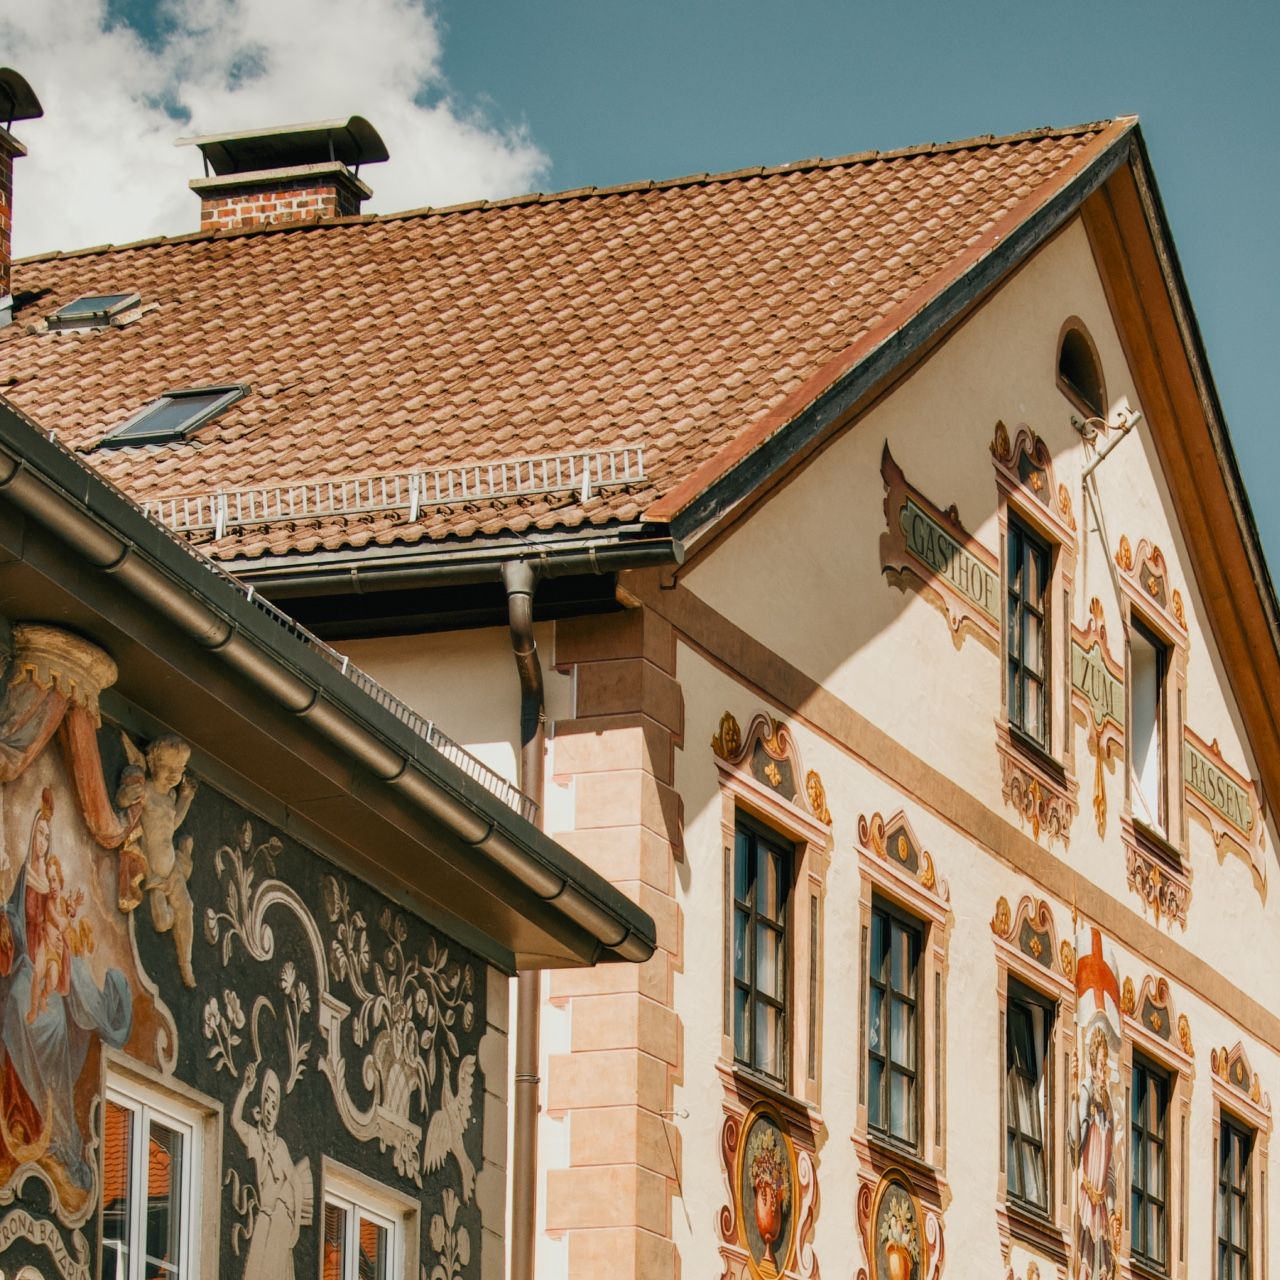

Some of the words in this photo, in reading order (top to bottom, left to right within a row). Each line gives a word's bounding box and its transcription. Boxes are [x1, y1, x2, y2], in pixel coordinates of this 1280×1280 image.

[912, 513, 994, 610] GASTHOF
[1081, 655, 1114, 715] ZUM
[1190, 751, 1245, 826] RASSEN
